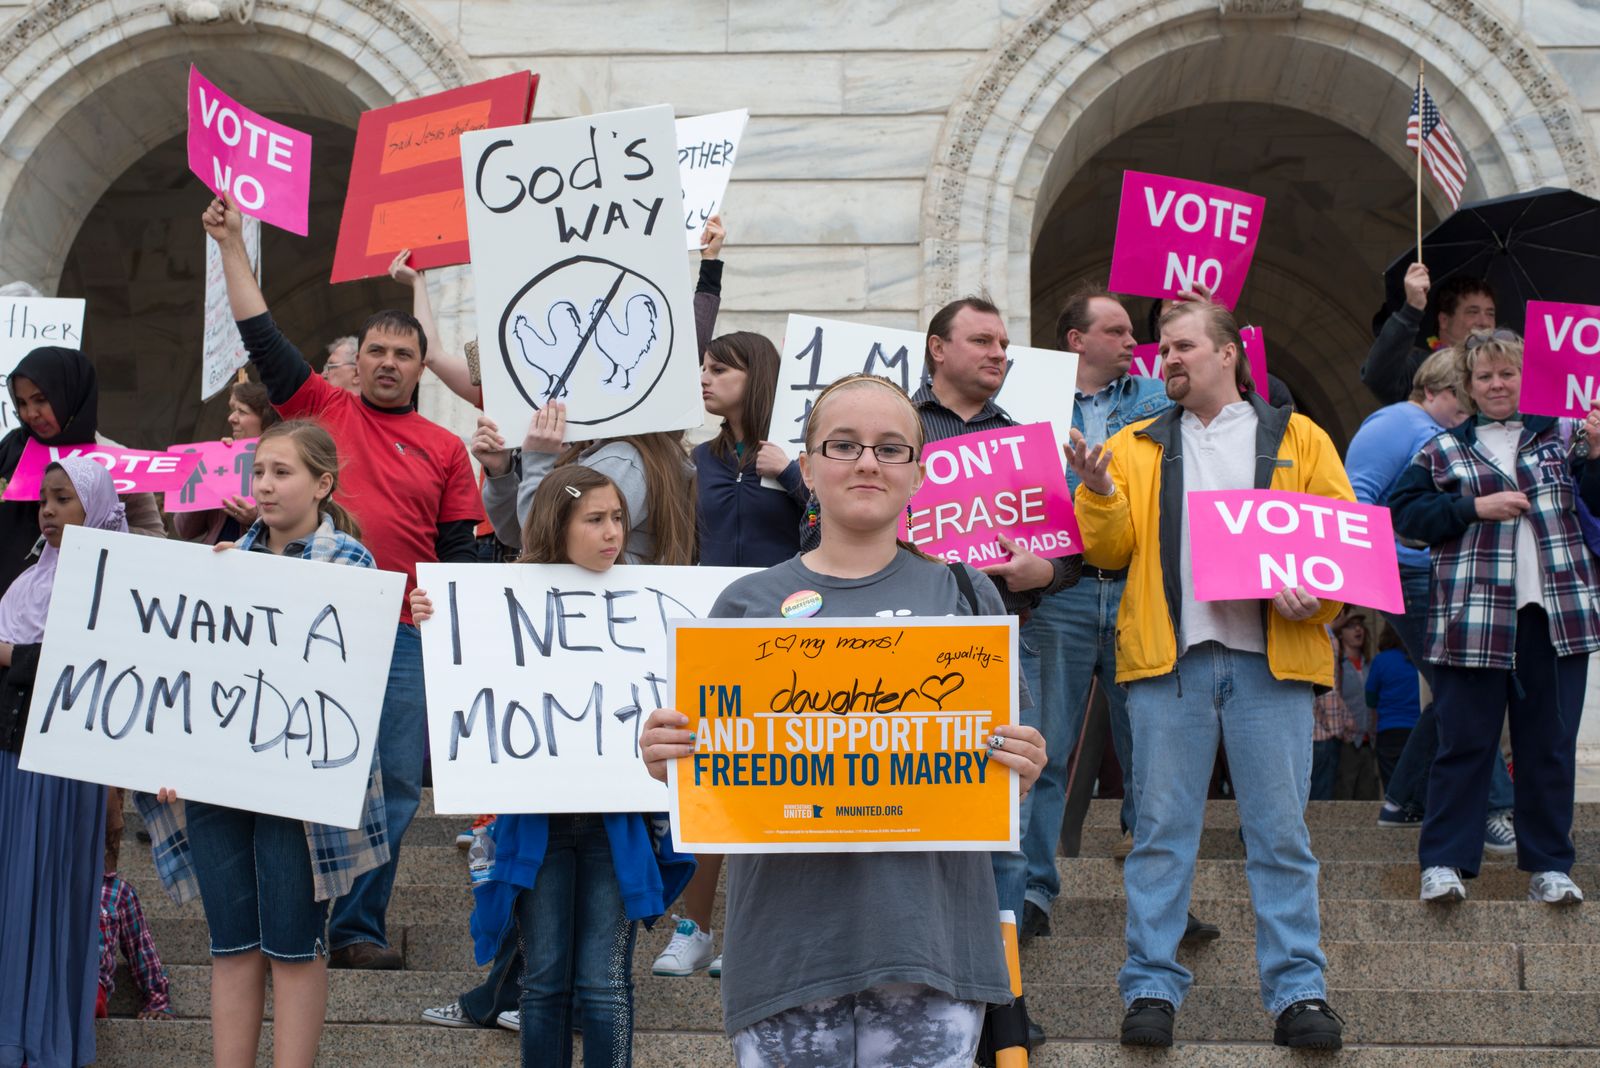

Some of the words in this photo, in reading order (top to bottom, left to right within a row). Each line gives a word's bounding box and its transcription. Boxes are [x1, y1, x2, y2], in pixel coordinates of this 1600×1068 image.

[199, 86, 293, 173] VOTE
[213, 156, 265, 210] NO
[476, 126, 654, 213] God's
[555, 198, 664, 243] WAY
[1144, 187, 1252, 245] VOTE
[1163, 252, 1222, 296] NO
[1544, 314, 1600, 355] VO
[1565, 374, 1600, 412] N
[926, 435, 1025, 485] ON'T
[907, 487, 1045, 546] ERASE
[1214, 500, 1372, 549] VOTE
[1015, 530, 1072, 552] DADS
[1259, 553, 1344, 591] NO
[87, 549, 108, 630] I
[130, 588, 284, 647] WANT
[303, 604, 347, 663] A
[448, 581, 462, 665] I
[755, 640, 774, 661] I
[800, 637, 825, 659] my
[836, 631, 904, 654] moms!
[40, 658, 193, 740] MOM
[244, 668, 360, 769] DAD
[699, 685, 741, 717] I'M
[770, 669, 920, 715] daughter
[694, 718, 755, 752] AND
[767, 718, 774, 752] I
[785, 717, 928, 752] SUPPORT
[936, 716, 992, 750] THE
[694, 753, 834, 786] FREEDOM
[843, 753, 879, 786] TO
[890, 751, 990, 785] MARRY
[784, 809, 812, 819] UNITED
[835, 805, 903, 817] MNUNITED.ORG
